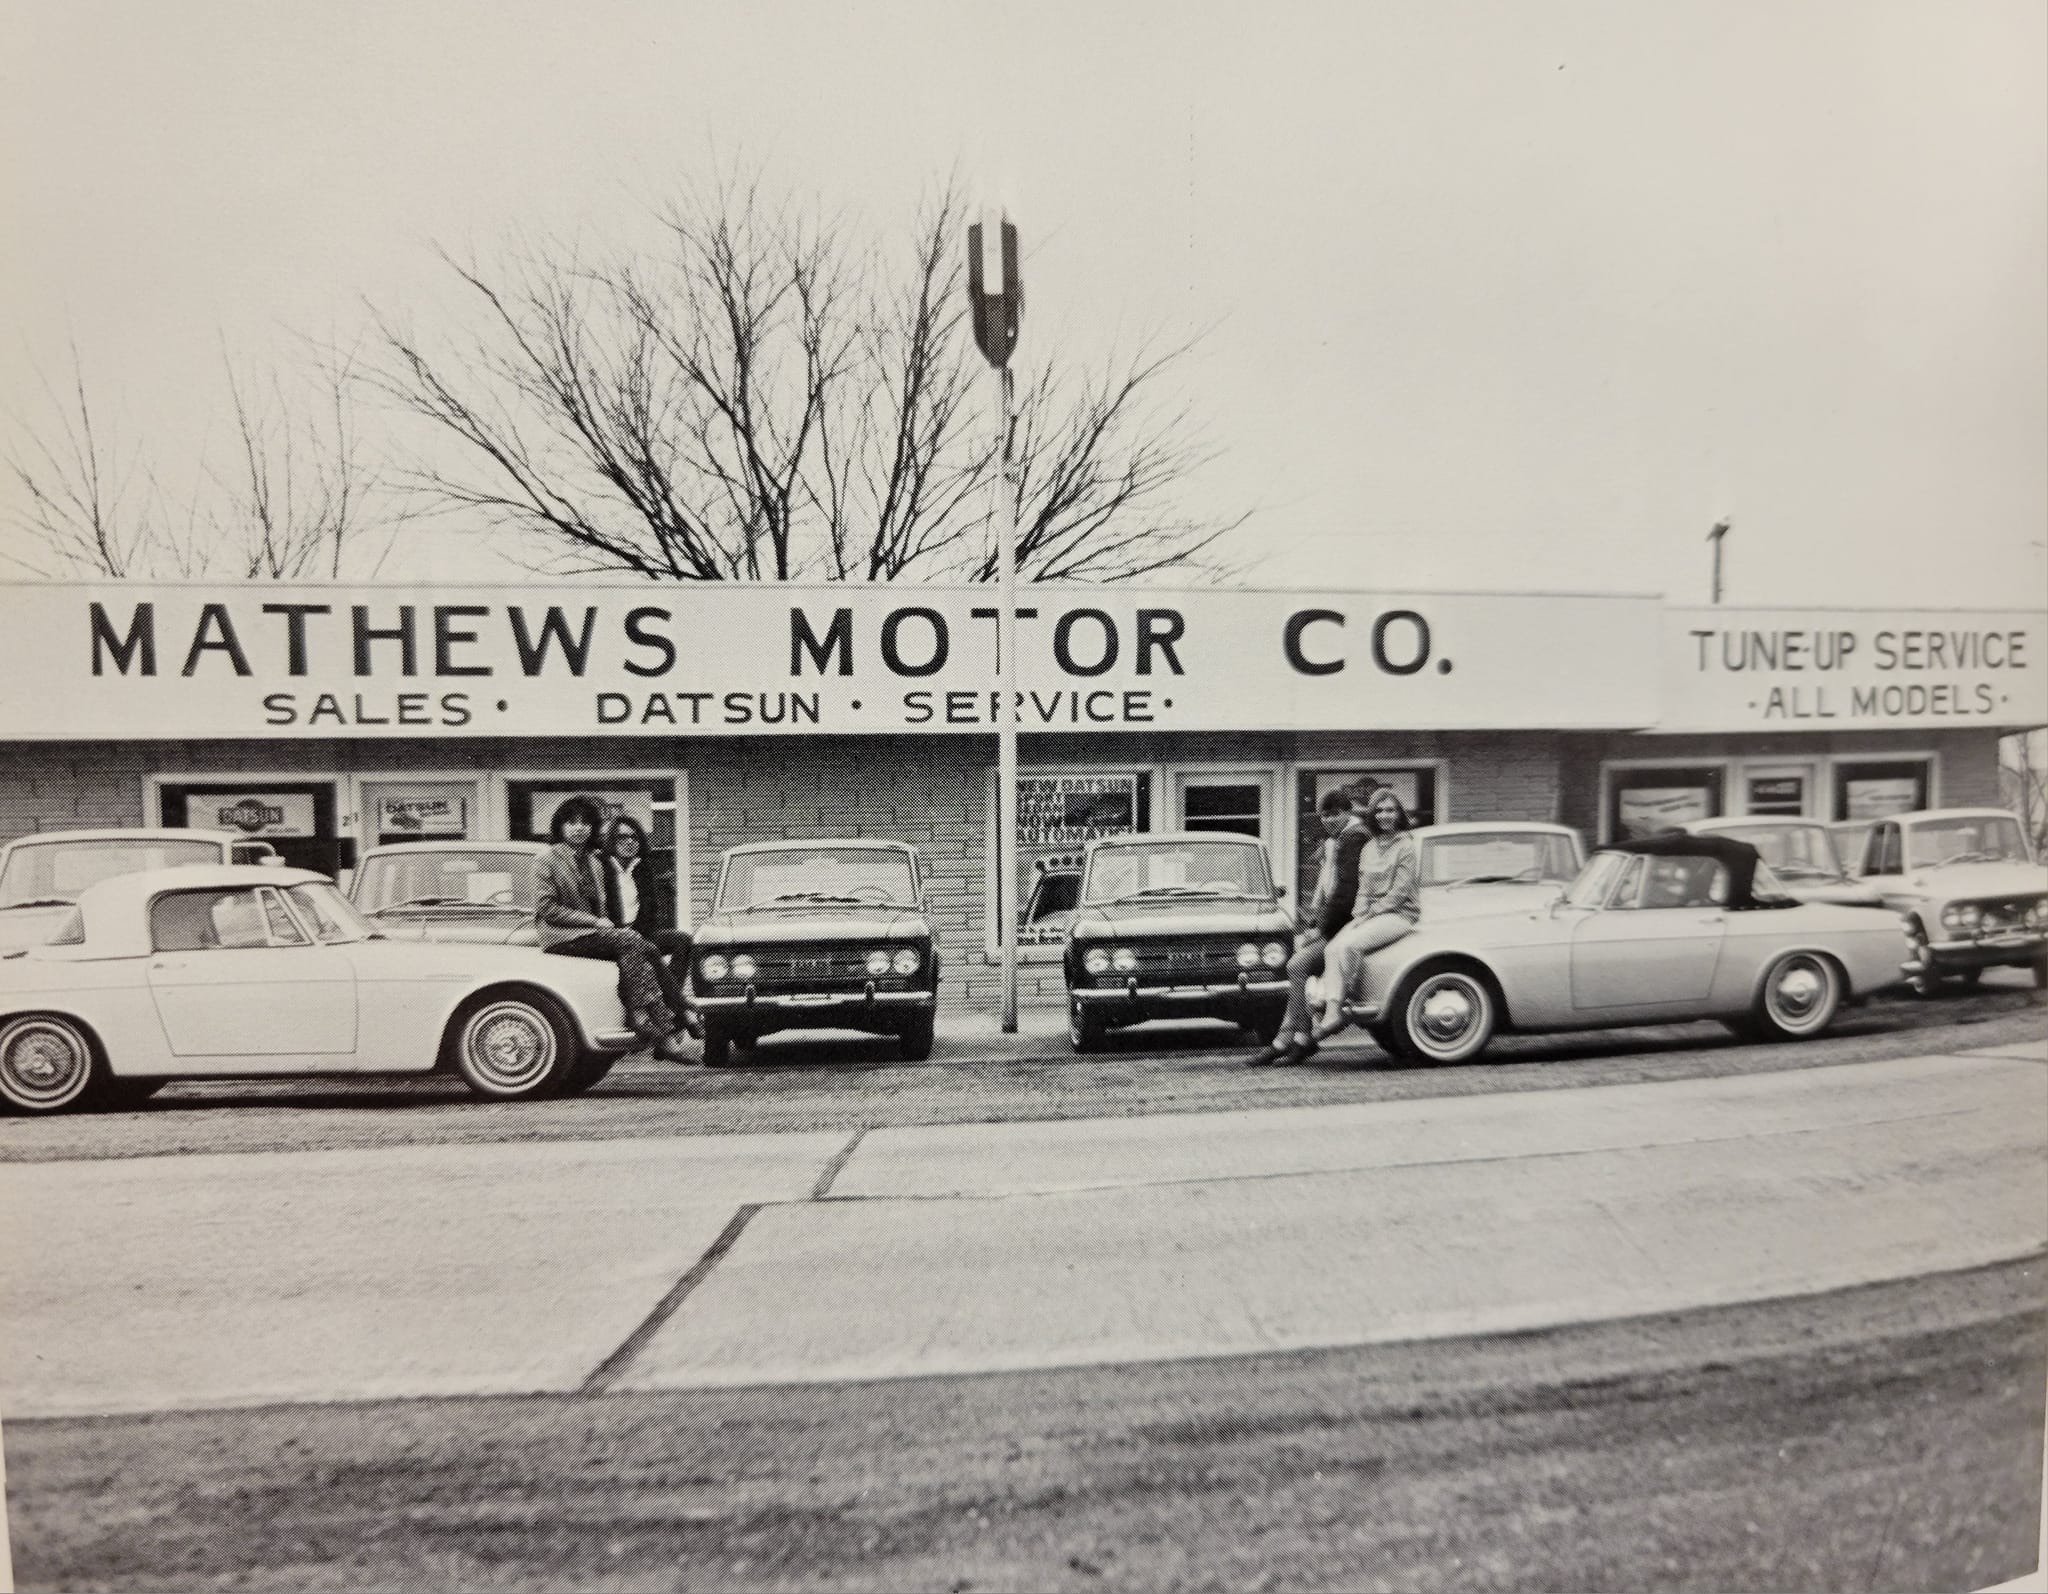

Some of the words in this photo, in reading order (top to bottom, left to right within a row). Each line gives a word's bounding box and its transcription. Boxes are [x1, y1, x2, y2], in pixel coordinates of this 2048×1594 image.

[90, 602, 677, 678] MATHEWS
[790, 606, 1186, 678] MOTOR
[1283, 607, 1454, 677] CO.
[1690, 629, 1858, 673] TUNE-UP
[1876, 629, 2030, 672] SERVICE
[263, 692, 471, 727] SALES
[597, 691, 820, 725] DATSUN
[904, 690, 1155, 724] SERVICE
[1764, 686, 1836, 720] ALL
[1850, 682, 1993, 719] MODELS
[1061, 779, 1133, 794] DATSUN
[222, 807, 281, 825] DATSUN
